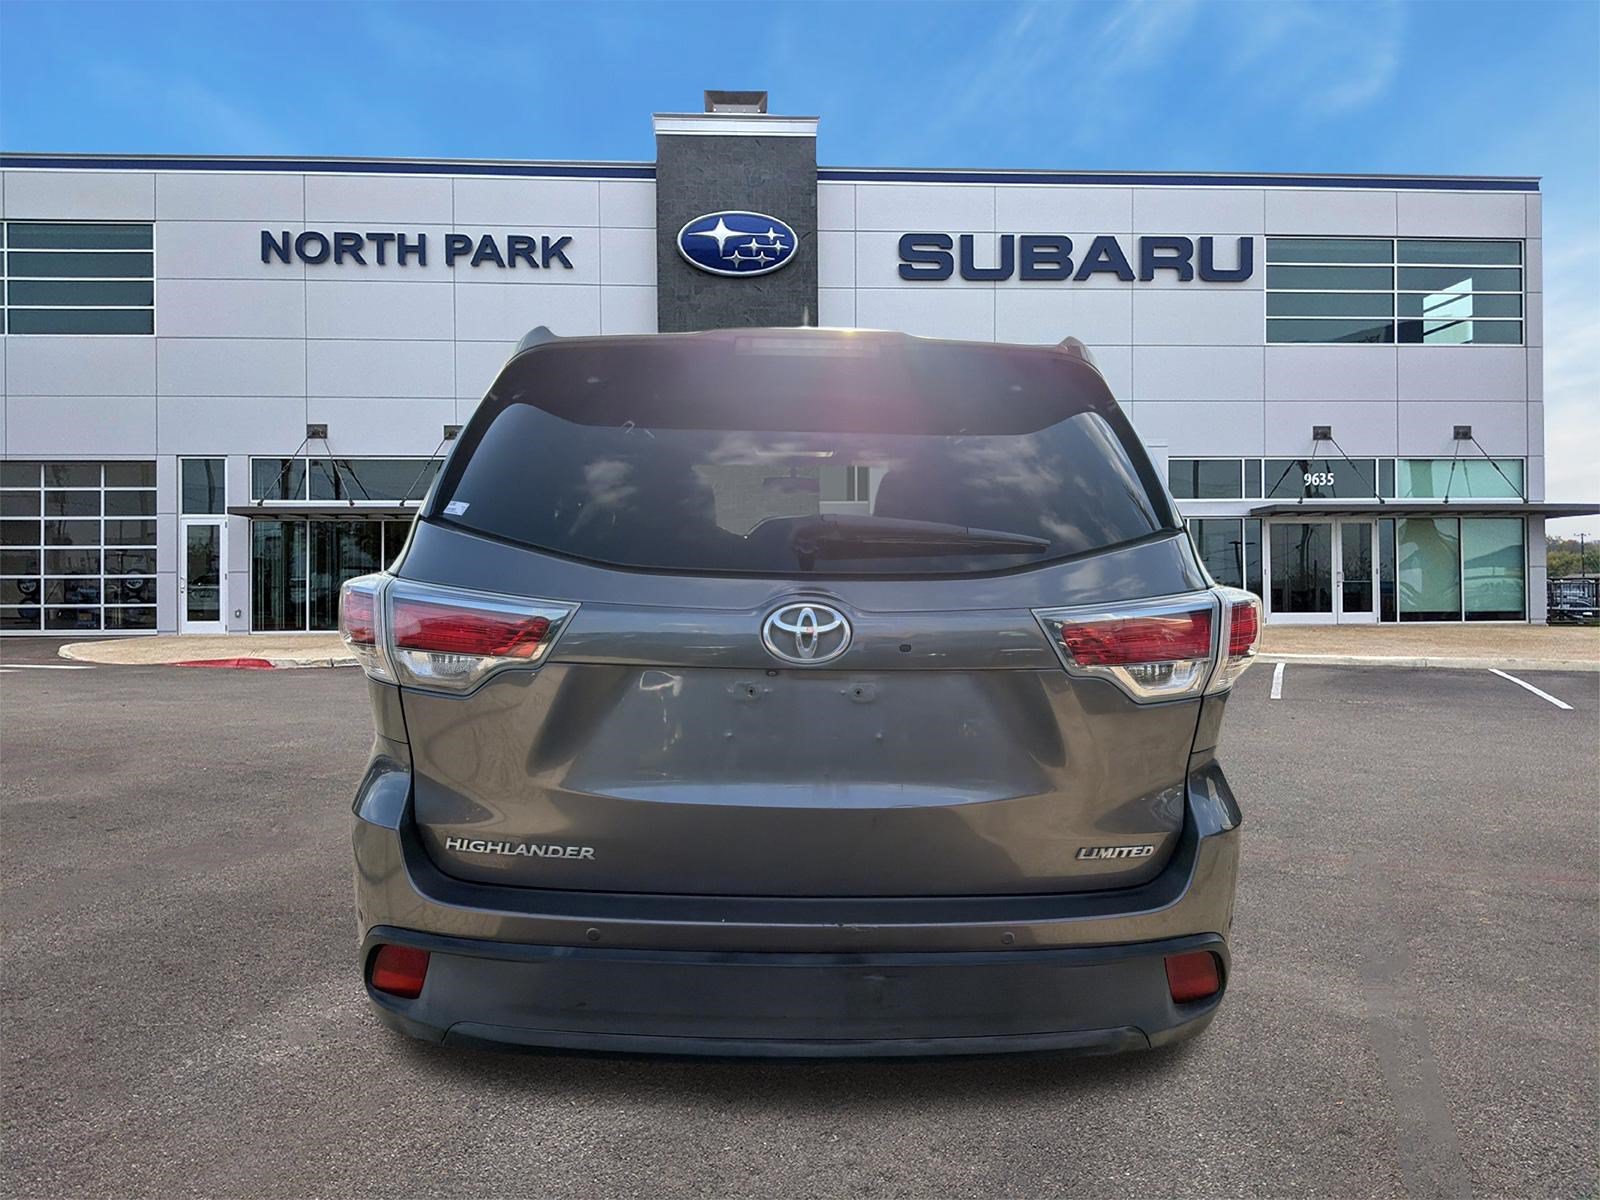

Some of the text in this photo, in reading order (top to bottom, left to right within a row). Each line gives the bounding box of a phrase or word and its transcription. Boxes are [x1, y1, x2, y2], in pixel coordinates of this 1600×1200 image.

[260, 230, 574, 269] NORTH PARK
[898, 233, 1254, 282] SUBARU
[1303, 472, 1335, 486] 9635
[445, 837, 596, 861] HIGHLANDER
[1076, 845, 1155, 860] LIMITED
